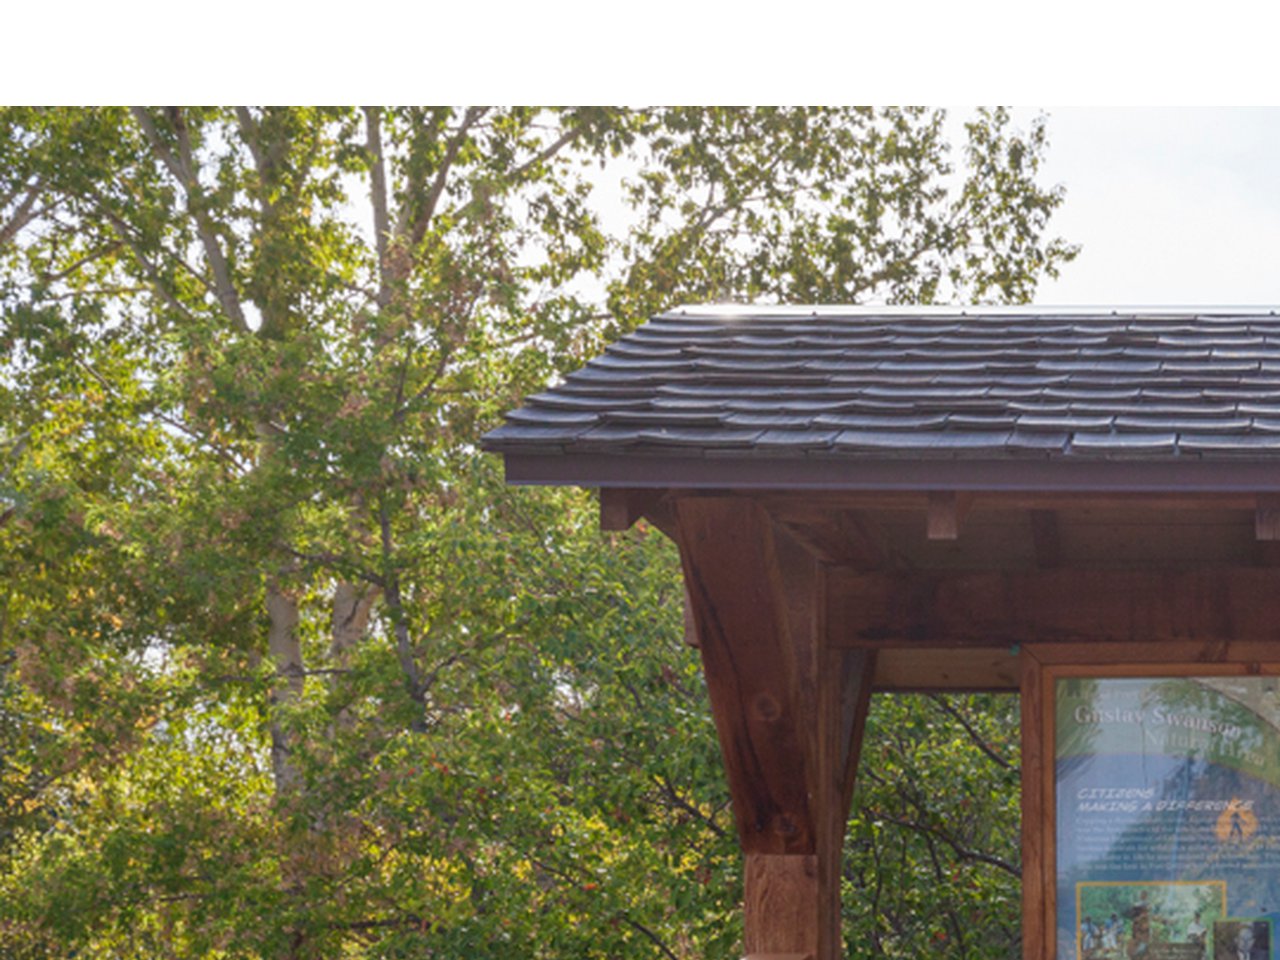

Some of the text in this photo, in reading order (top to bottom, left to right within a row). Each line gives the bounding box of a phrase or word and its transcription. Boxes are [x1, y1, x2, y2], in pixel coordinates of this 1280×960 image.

[1074, 705, 1242, 739] Gustav Swanson
[1077, 800, 1255, 813] MAKING A DIFFERENCE
